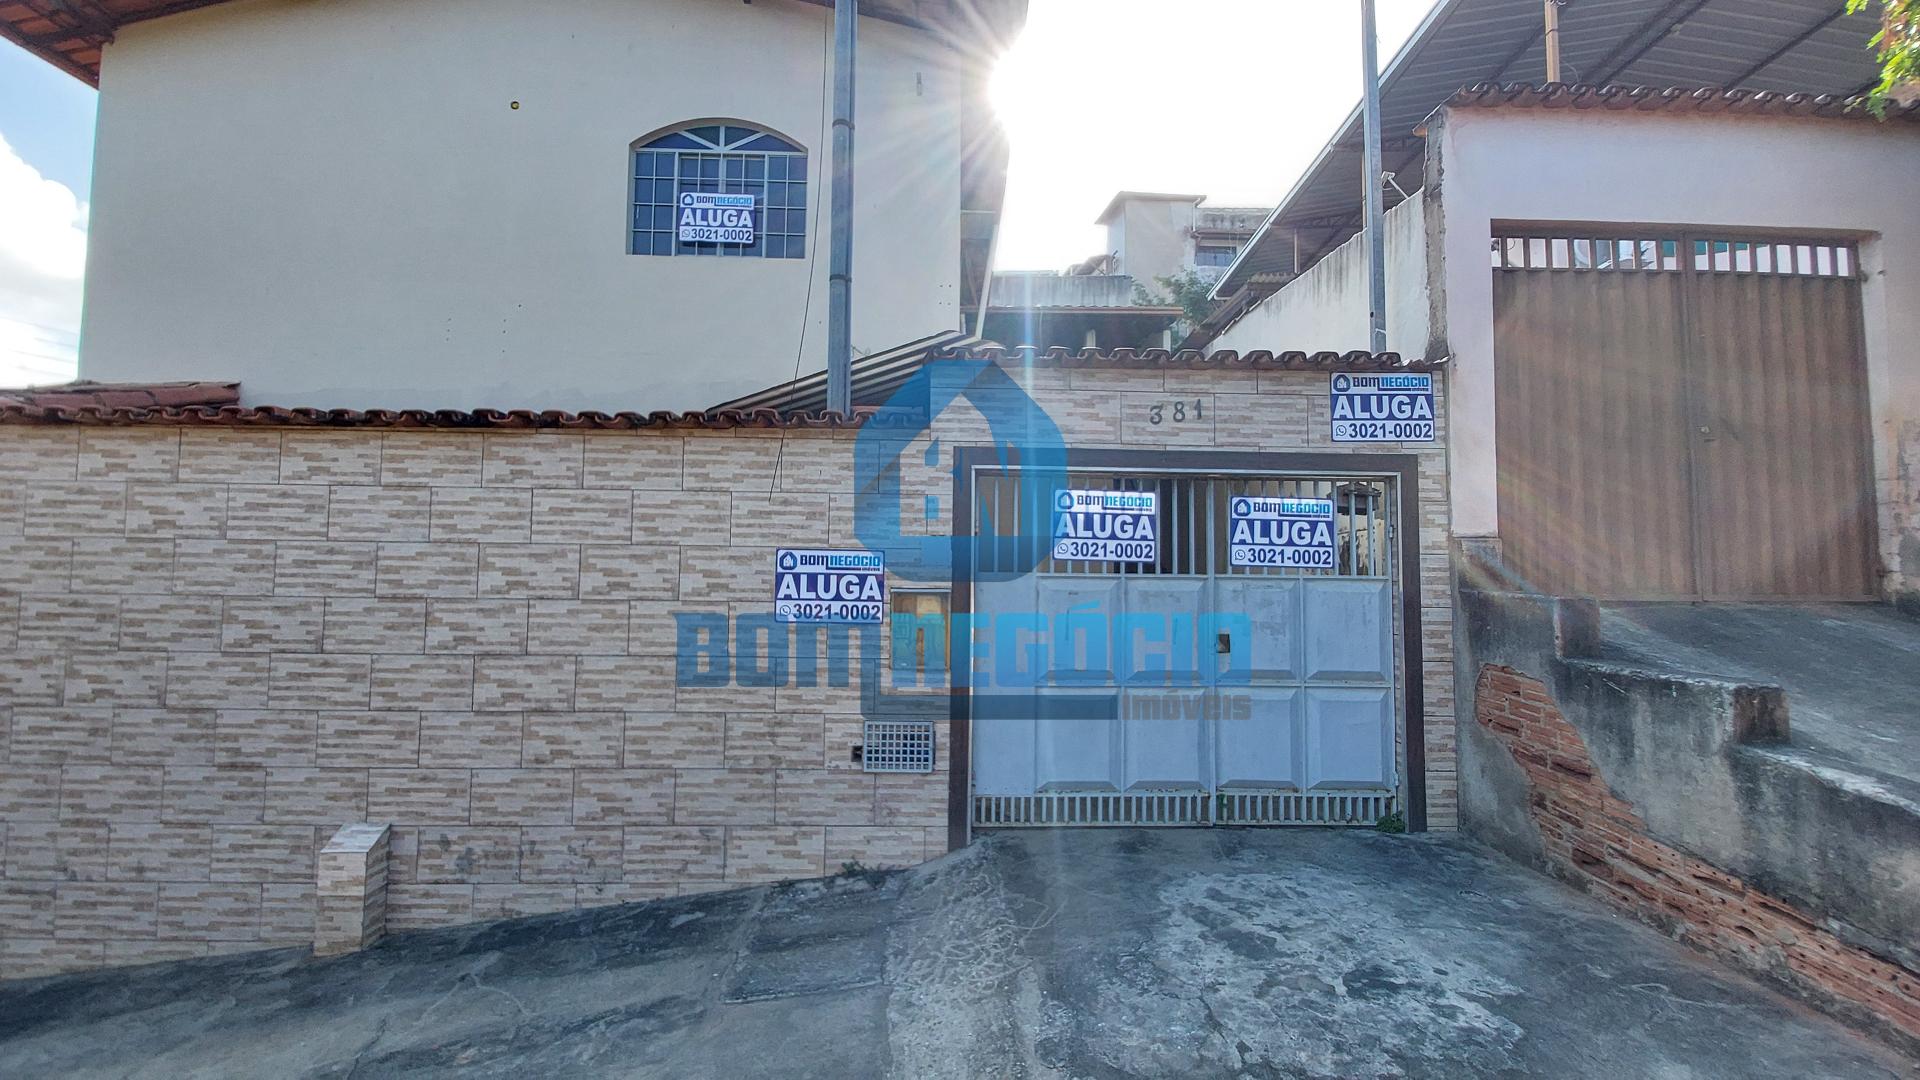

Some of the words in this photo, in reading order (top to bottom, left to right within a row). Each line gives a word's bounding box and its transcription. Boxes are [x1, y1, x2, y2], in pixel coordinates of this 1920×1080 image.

[680, 208, 753, 227] ALUGA
[691, 228, 752, 241] 3021-0002
[1149, 398, 1202, 425] 381
[1333, 395, 1433, 419] ALUGA
[1349, 423, 1432, 438] 3021-0002
[1055, 513, 1154, 539] ALUGA
[1232, 520, 1332, 545] ALUGA
[1070, 541, 1153, 559] 3021-0002
[1248, 548, 1331, 565] 3021-0002
[777, 573, 882, 600] ALUGA
[793, 603, 881, 620] 3021-0002
